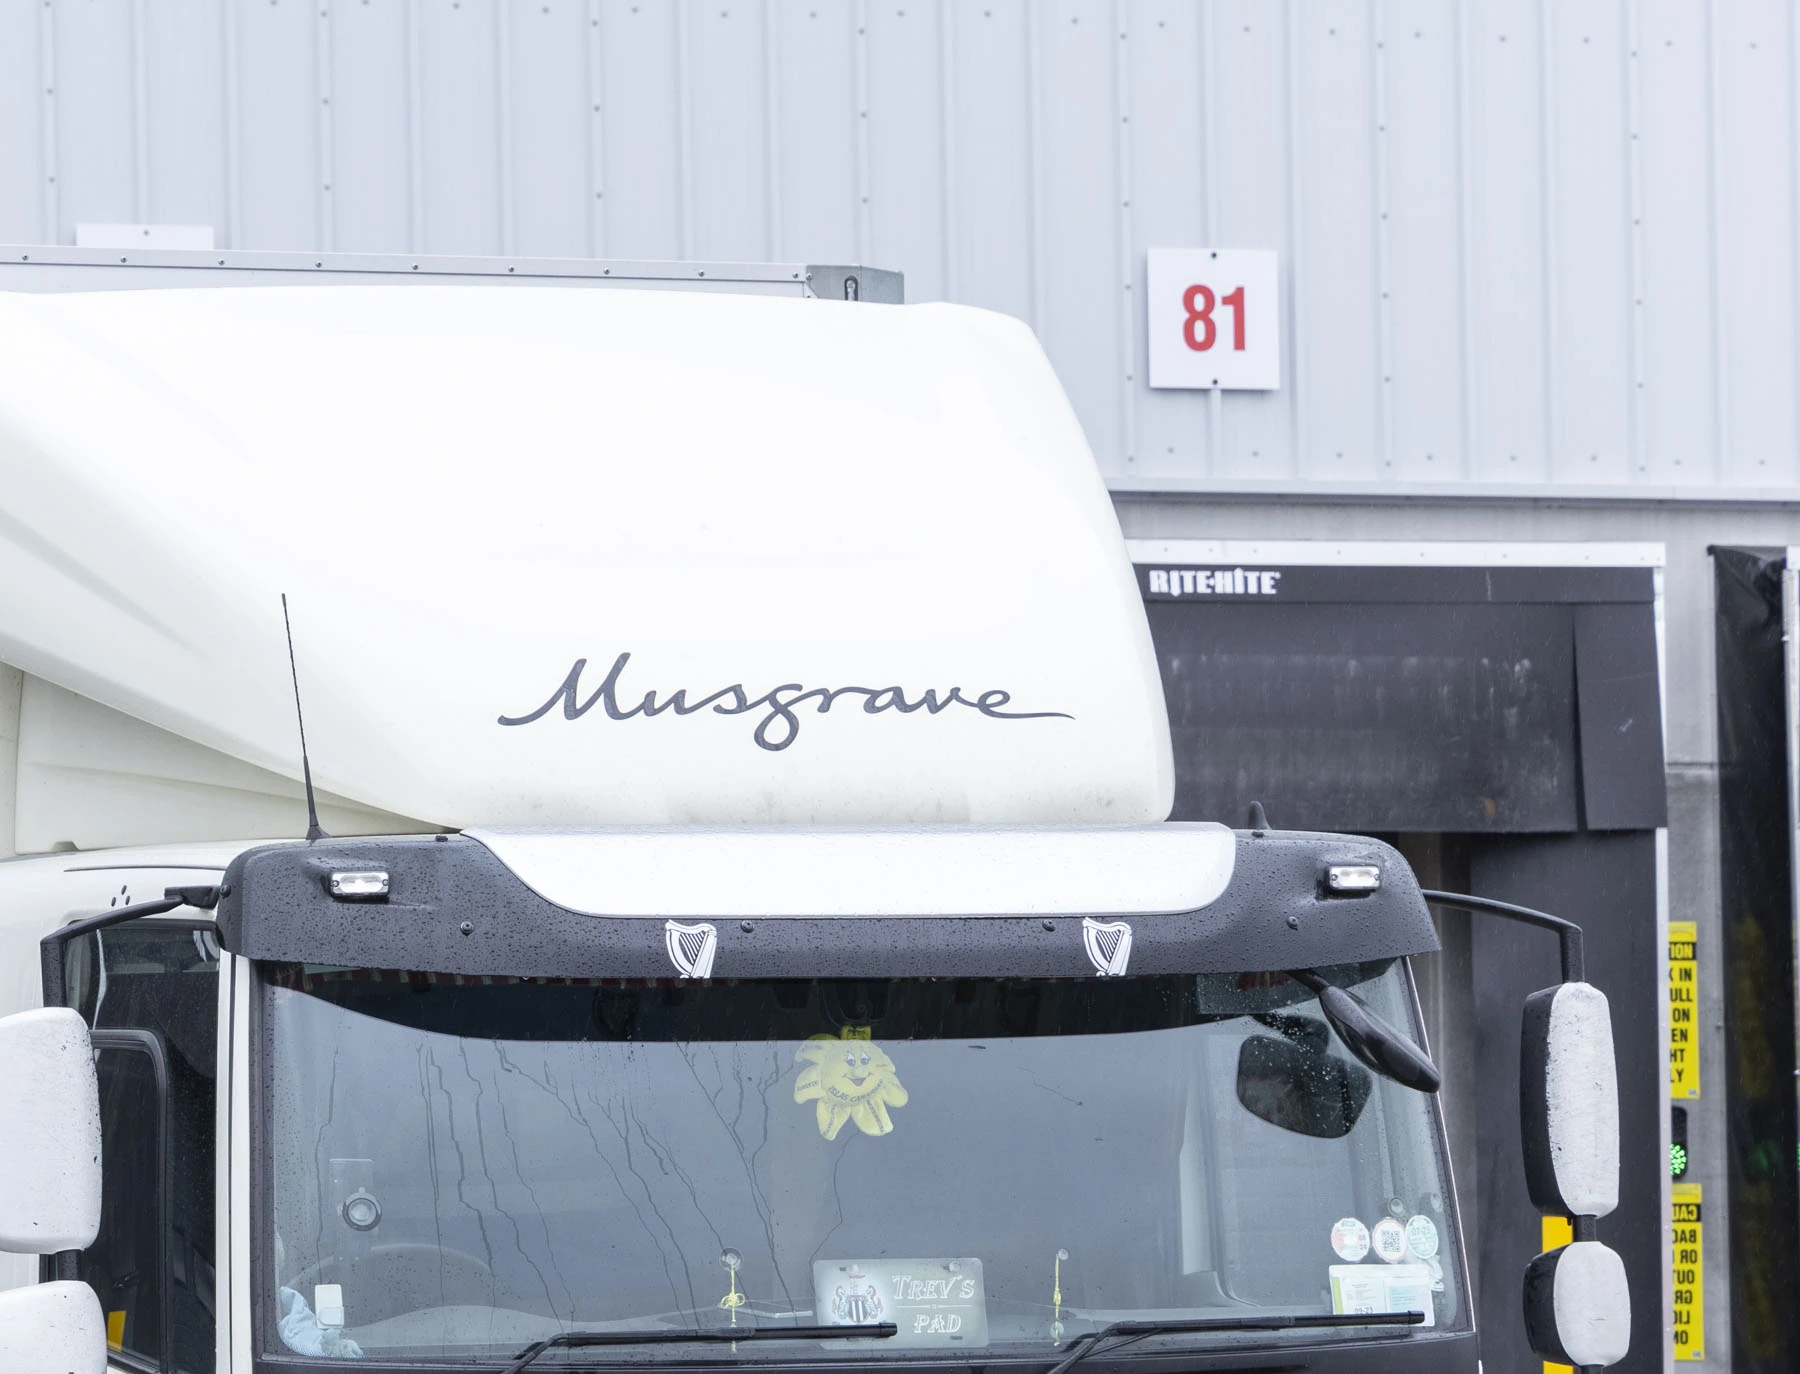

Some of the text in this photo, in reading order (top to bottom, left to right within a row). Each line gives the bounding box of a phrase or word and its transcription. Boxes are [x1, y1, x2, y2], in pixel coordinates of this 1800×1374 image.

[1182, 284, 1246, 352] 81
[497, 652, 1075, 752] Musgrave
[1679, 967, 1692, 982] IN
[1669, 987, 1693, 1002] ULL
[1672, 1007, 1690, 1022] ON
[913, 1313, 962, 1334] PAD
